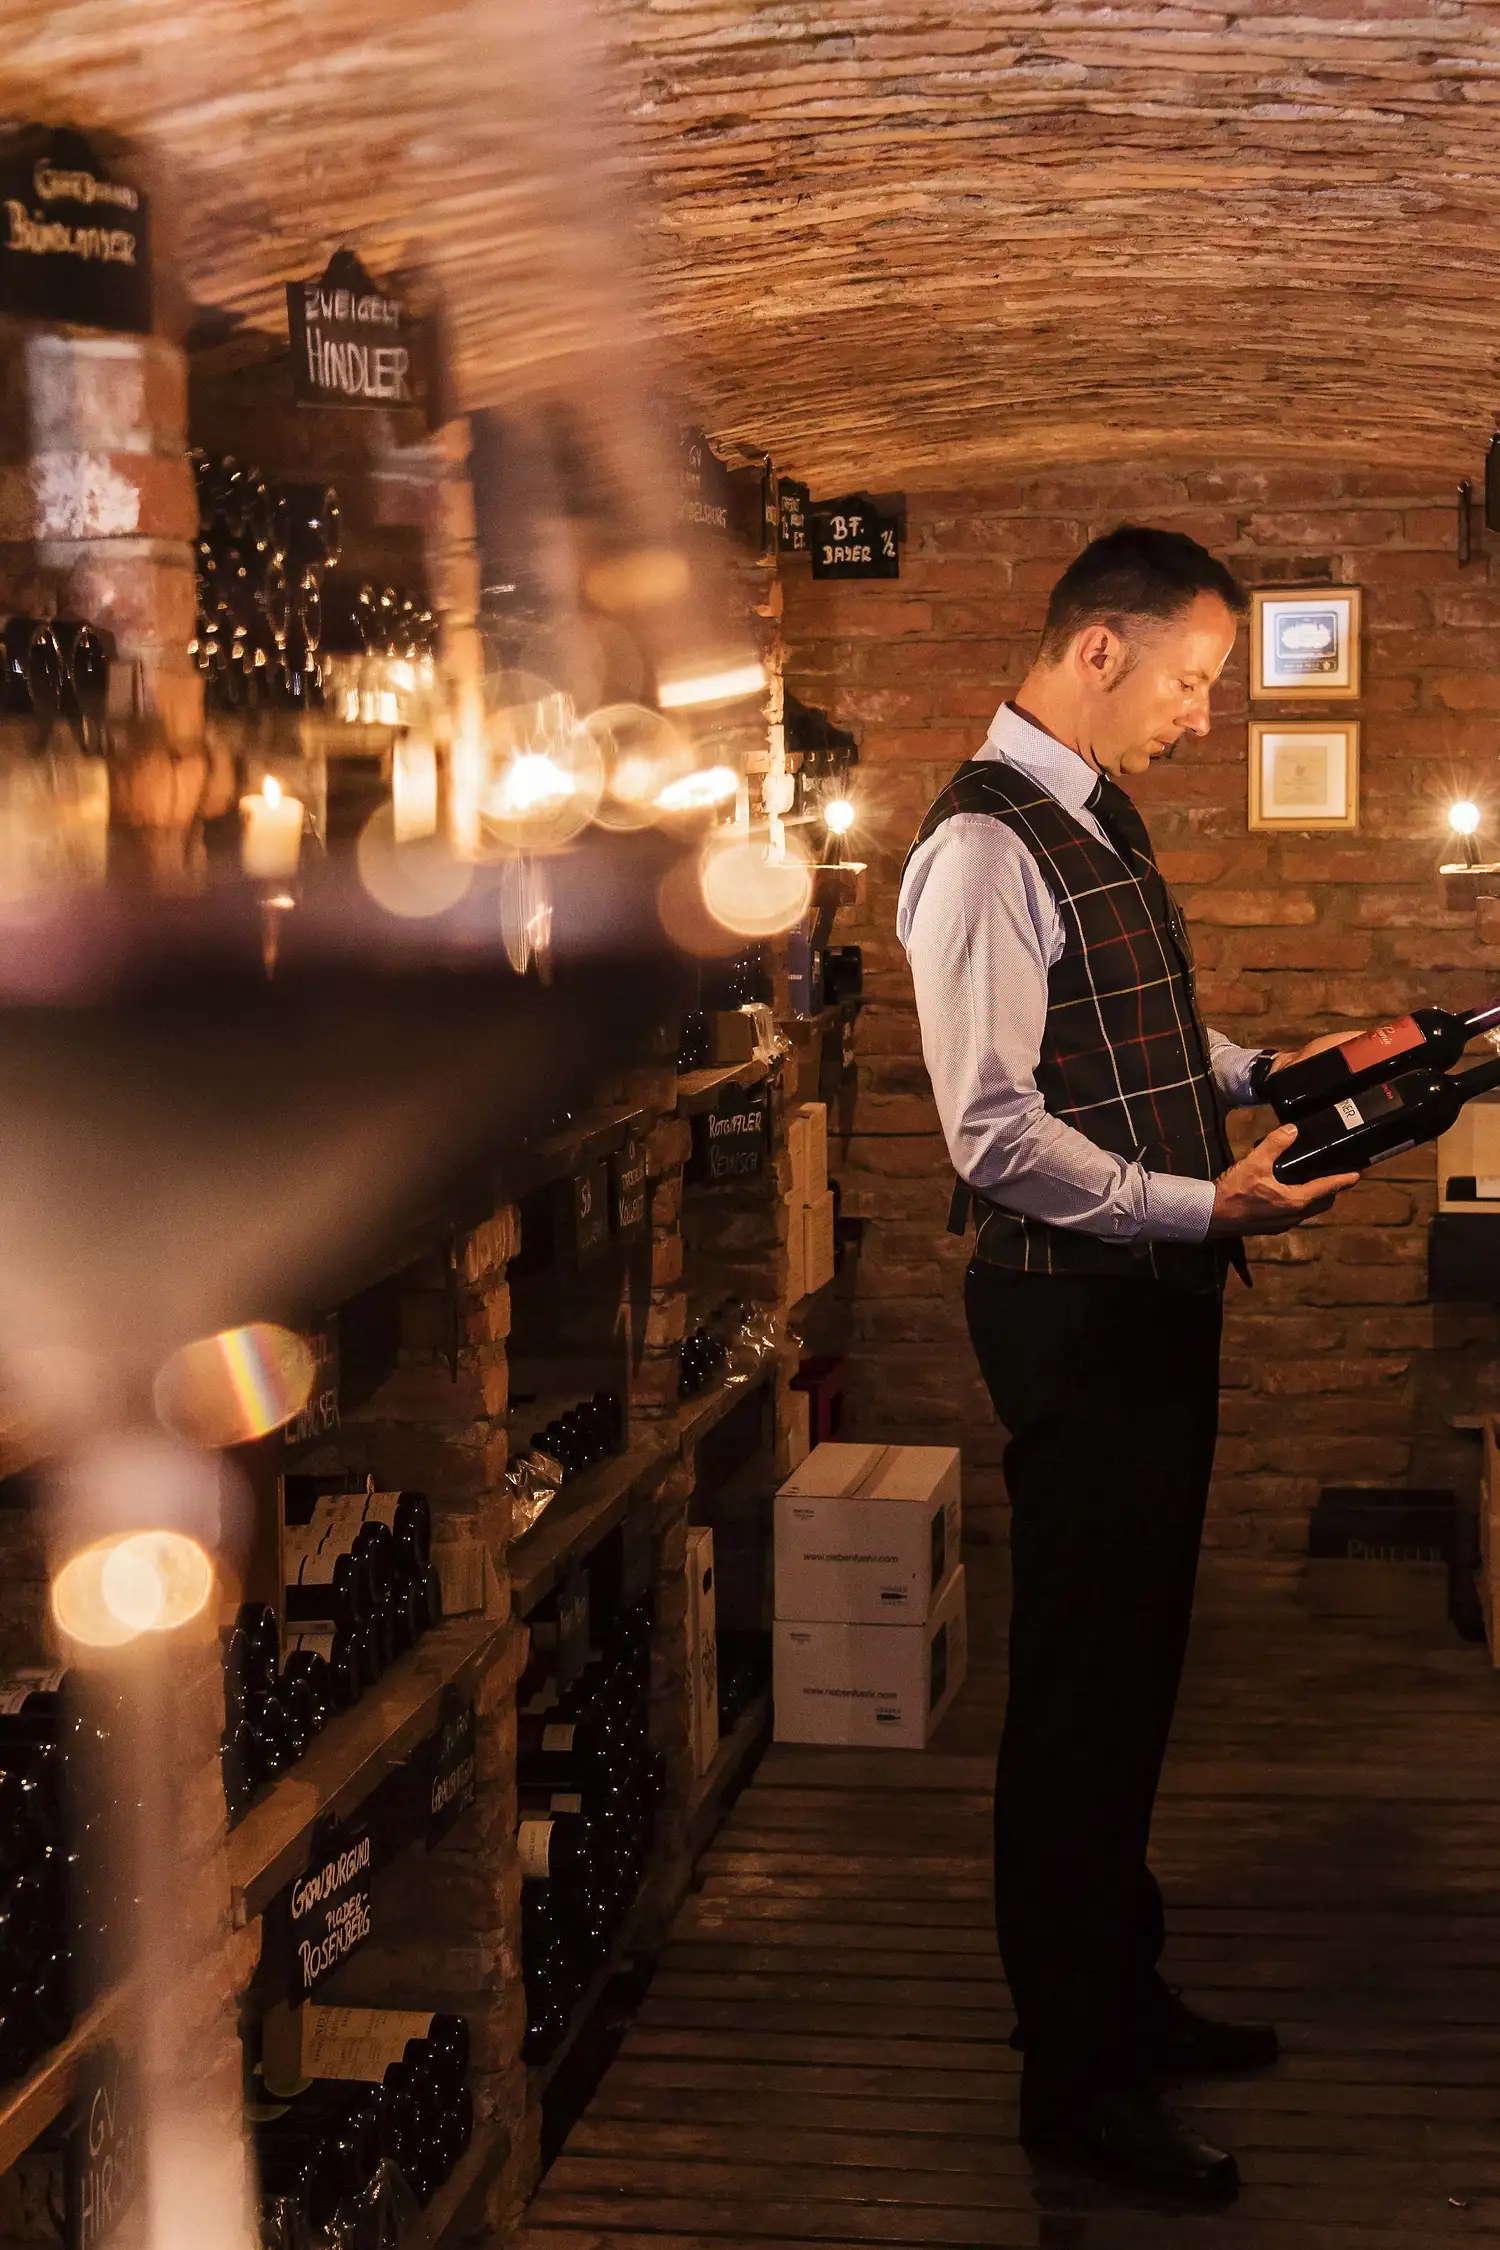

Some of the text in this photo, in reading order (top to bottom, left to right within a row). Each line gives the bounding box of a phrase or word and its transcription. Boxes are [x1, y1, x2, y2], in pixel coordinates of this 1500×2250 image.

[306, 326, 411, 401] HINDLER
[823, 545, 872, 566] BAYER
[298, 1904, 371, 1988] ROSENBERG
